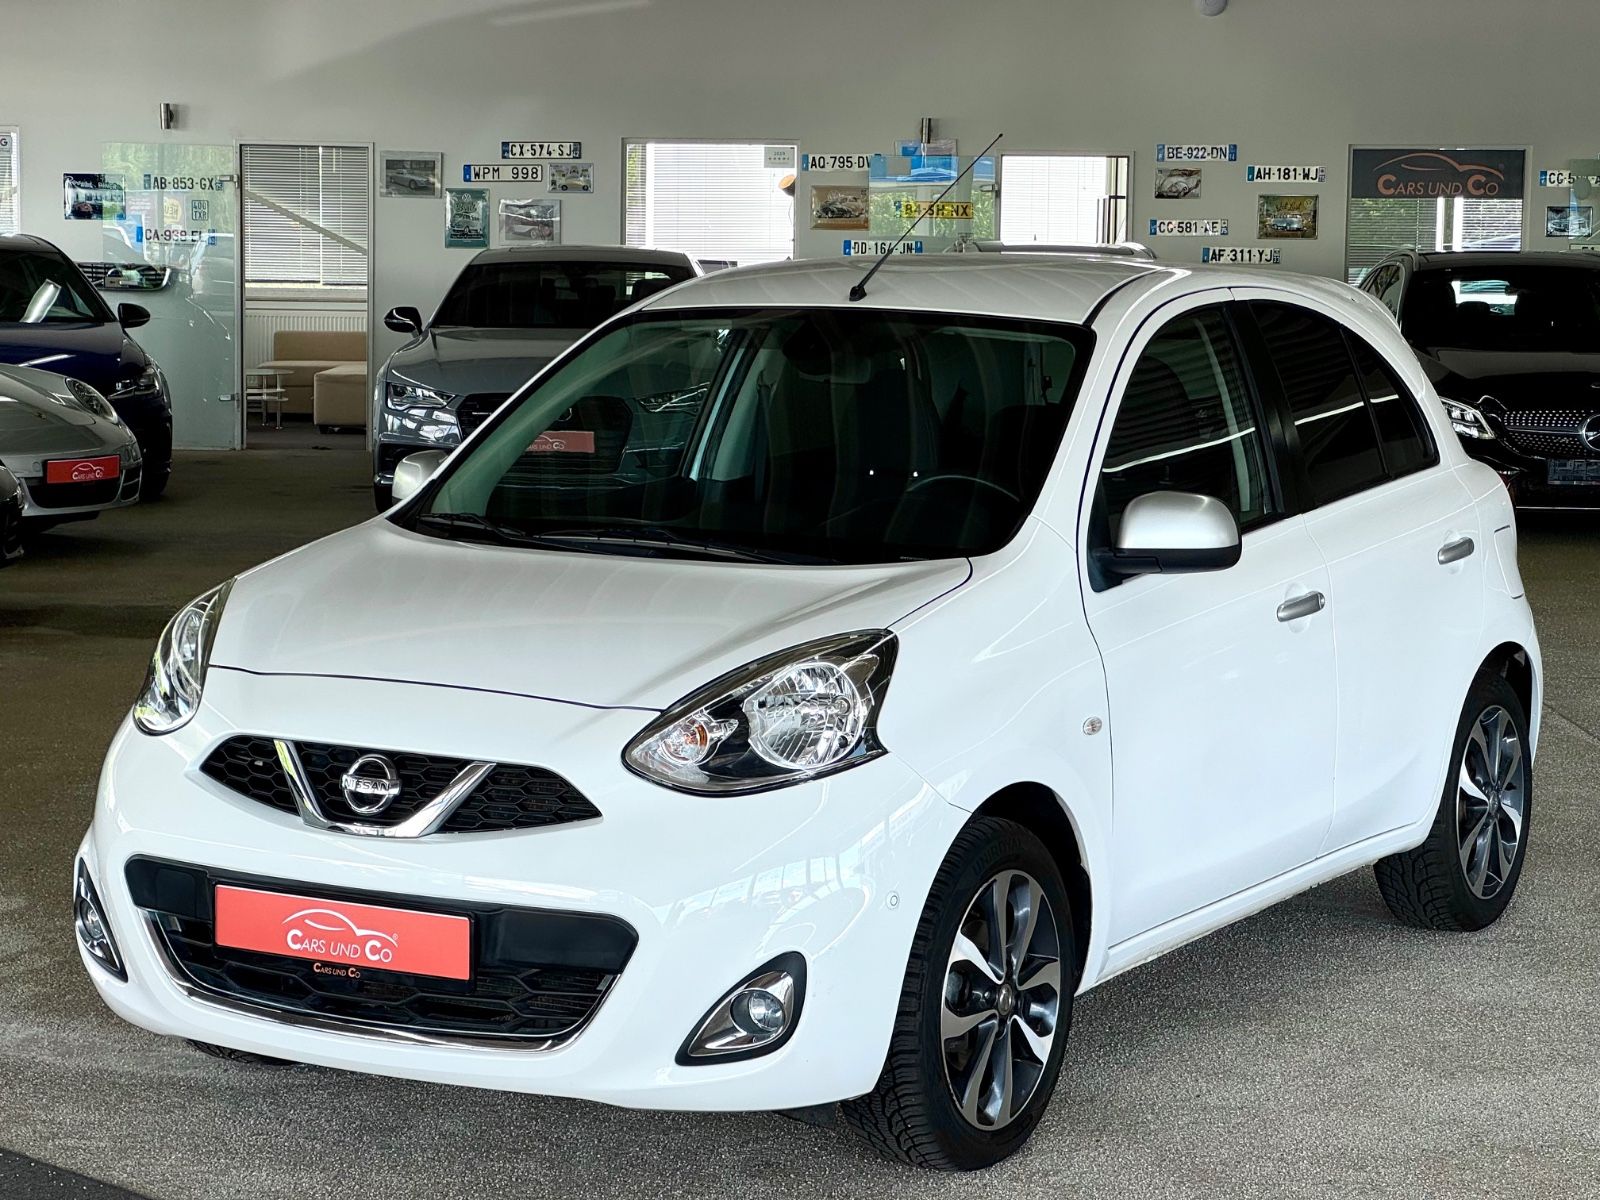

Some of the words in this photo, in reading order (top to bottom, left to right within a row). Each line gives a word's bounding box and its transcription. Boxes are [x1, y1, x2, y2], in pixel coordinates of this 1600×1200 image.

[1167, 147, 1227, 159] BE-922-DN
[473, 167, 500, 180] WPM
[511, 167, 539, 180] 998
[1255, 167, 1318, 180] AH-181-WJ
[153, 176, 214, 190] AB-853-GX
[1377, 174, 1425, 196] CARS
[1428, 182, 1463, 195] UND
[1467, 174, 1499, 196] CO
[1210, 249, 1273, 262] AF-311-YJ
[343, 776, 390, 791] NISSAN
[286, 929, 326, 955] CARS
[329, 942, 361, 959] UND
[364, 939, 393, 963] CO
[313, 962, 332, 975] CARS
[332, 967, 347, 977] UND
